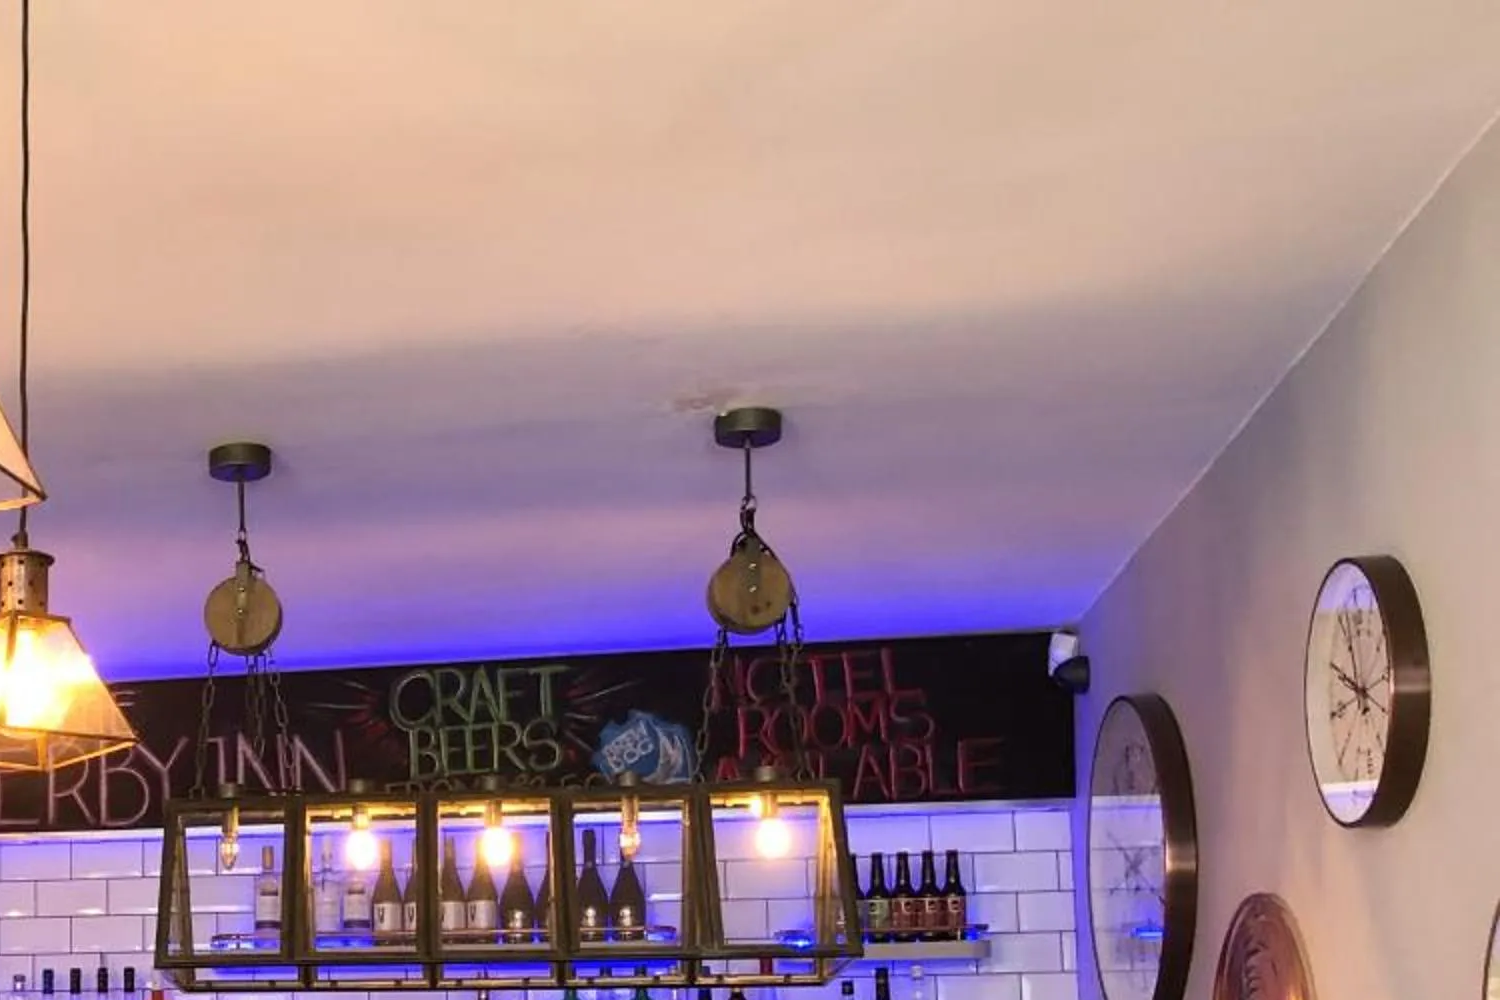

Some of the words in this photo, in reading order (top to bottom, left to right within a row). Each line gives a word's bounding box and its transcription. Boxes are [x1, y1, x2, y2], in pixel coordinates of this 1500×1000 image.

[389, 664, 573, 731] CRAFT
[736, 688, 936, 760] ROOMS
[208, 725, 346, 797] INN
[409, 716, 562, 780] BEERS
